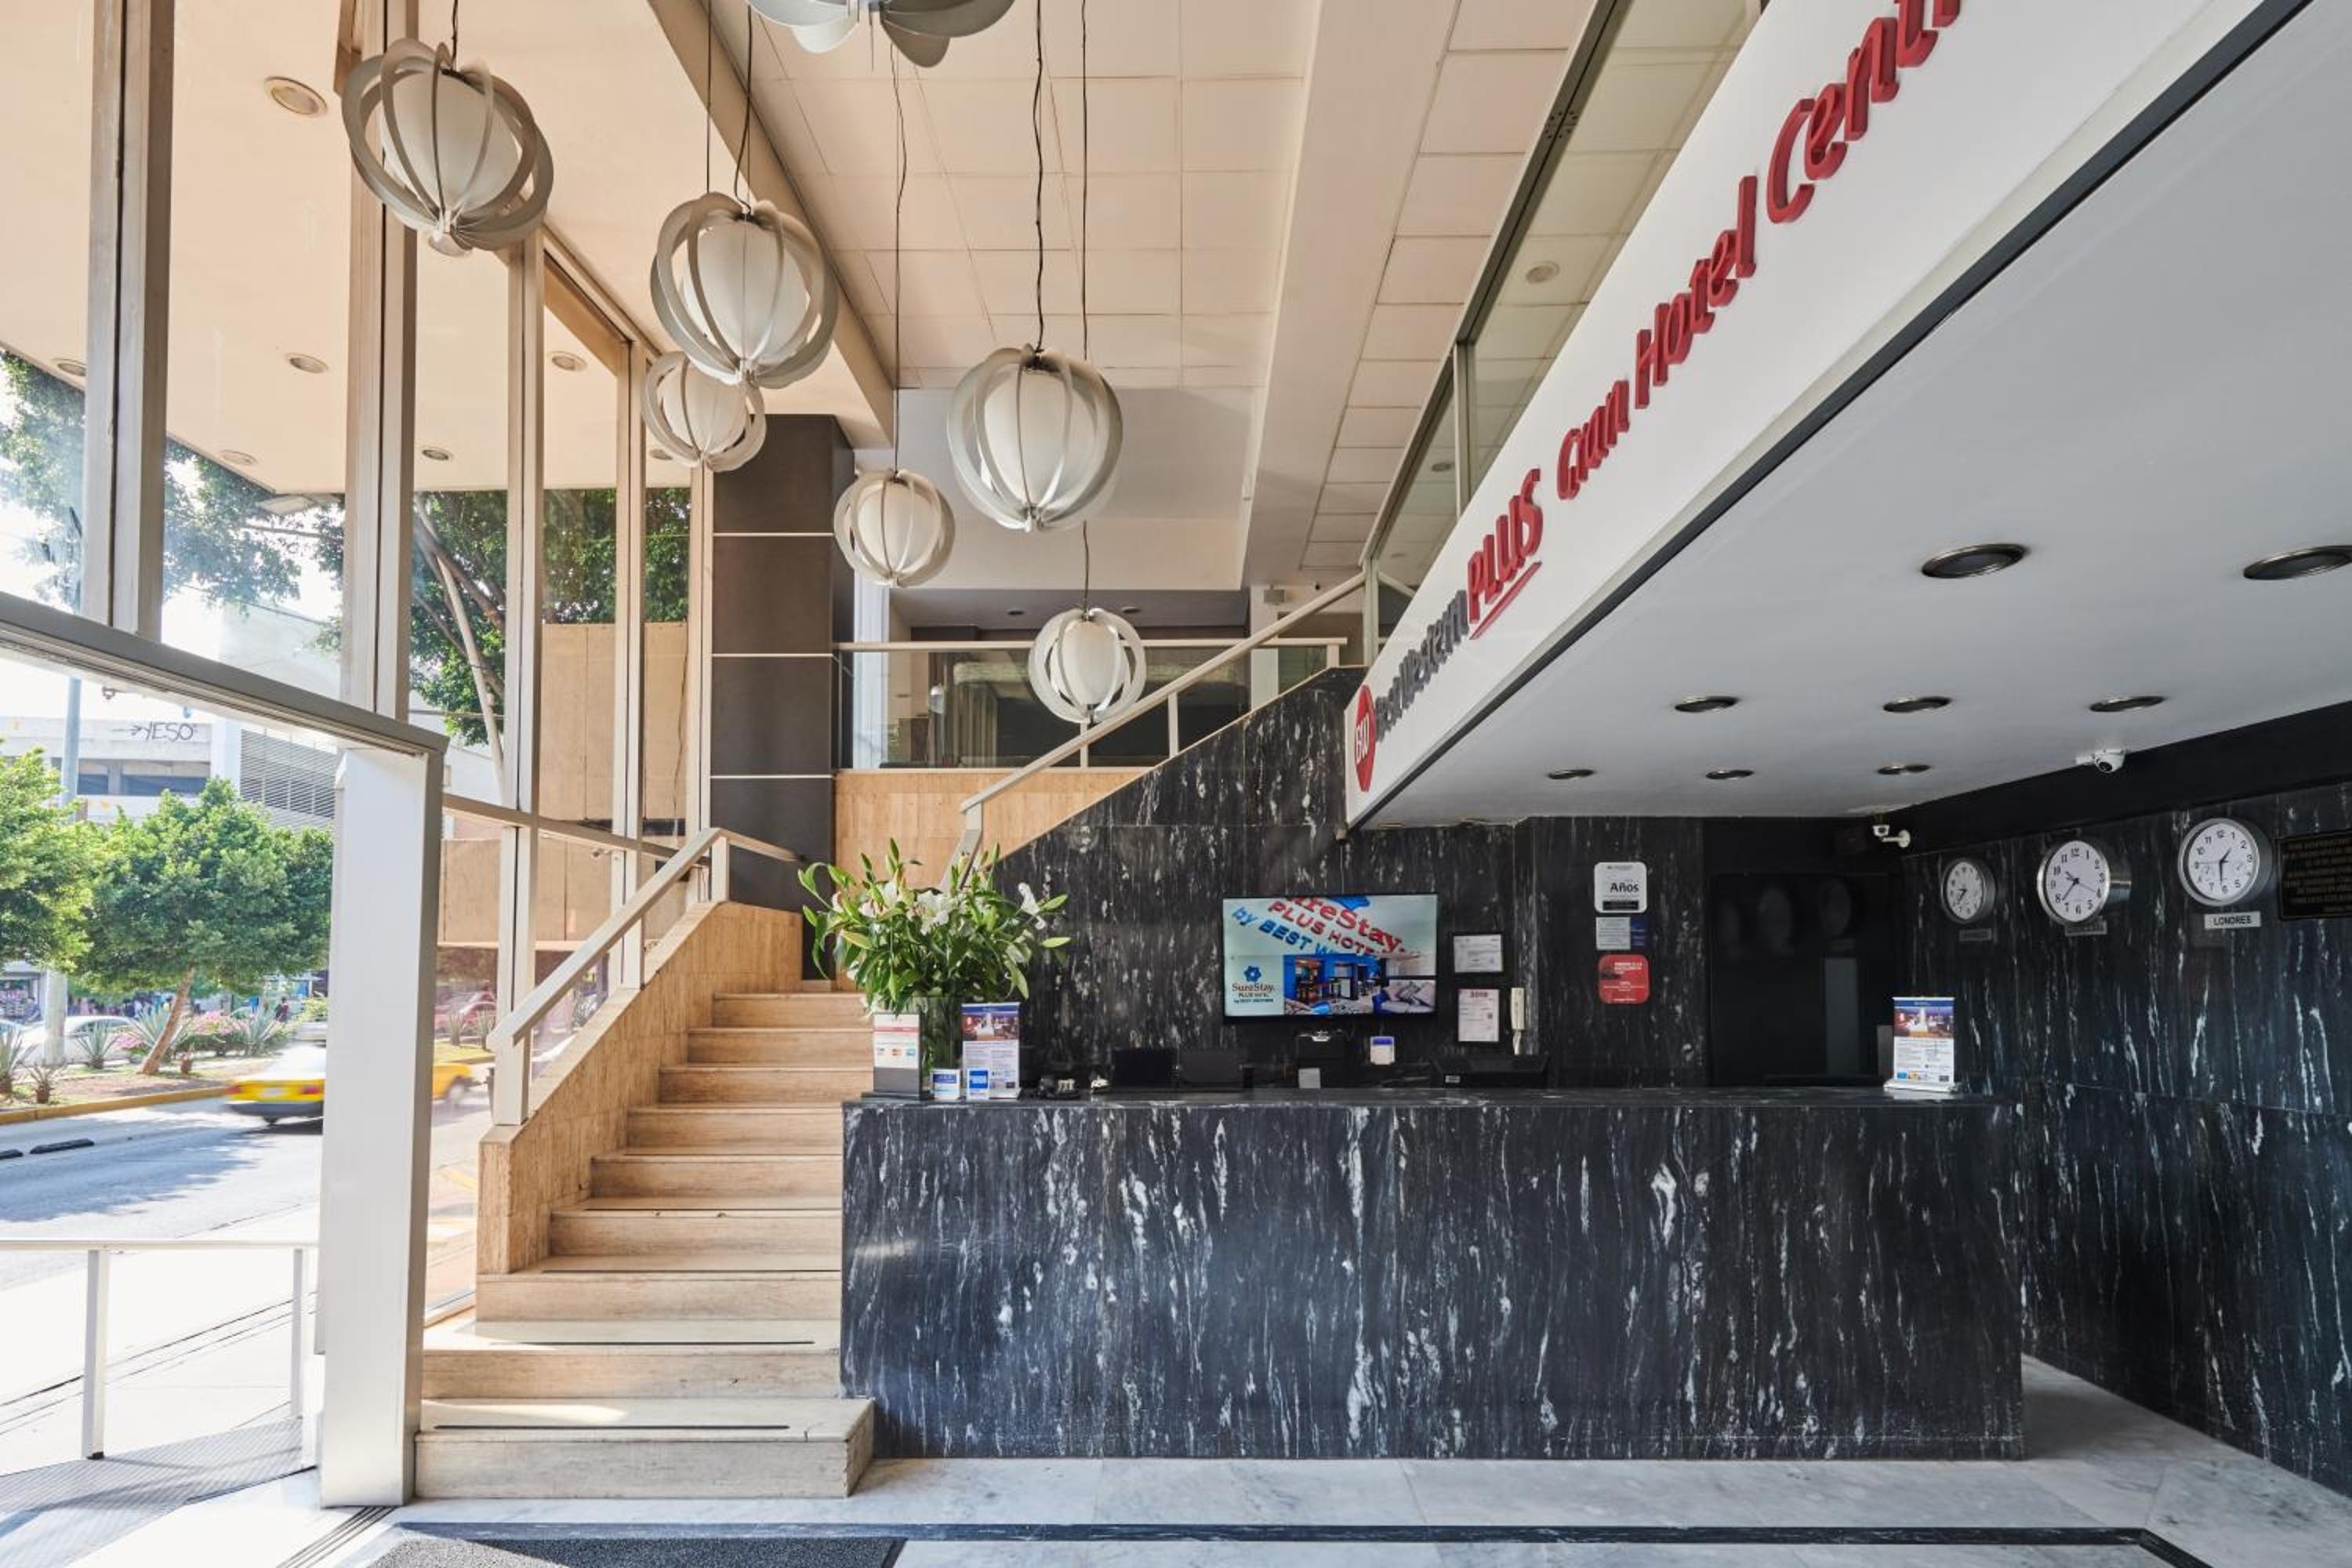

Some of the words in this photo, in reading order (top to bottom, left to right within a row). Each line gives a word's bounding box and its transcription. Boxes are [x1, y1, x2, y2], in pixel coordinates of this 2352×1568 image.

[1468, 468, 1543, 623] PLUS
[1635, 175, 1758, 409] Hotel
[1610, 882, 1640, 893] Años
[1232, 906, 1258, 926] by
[1258, 919, 1314, 950] BEST
[1268, 901, 1326, 935] PLUS
[1286, 898, 1402, 953] reStay
[2213, 915, 2252, 927] LONDRES
